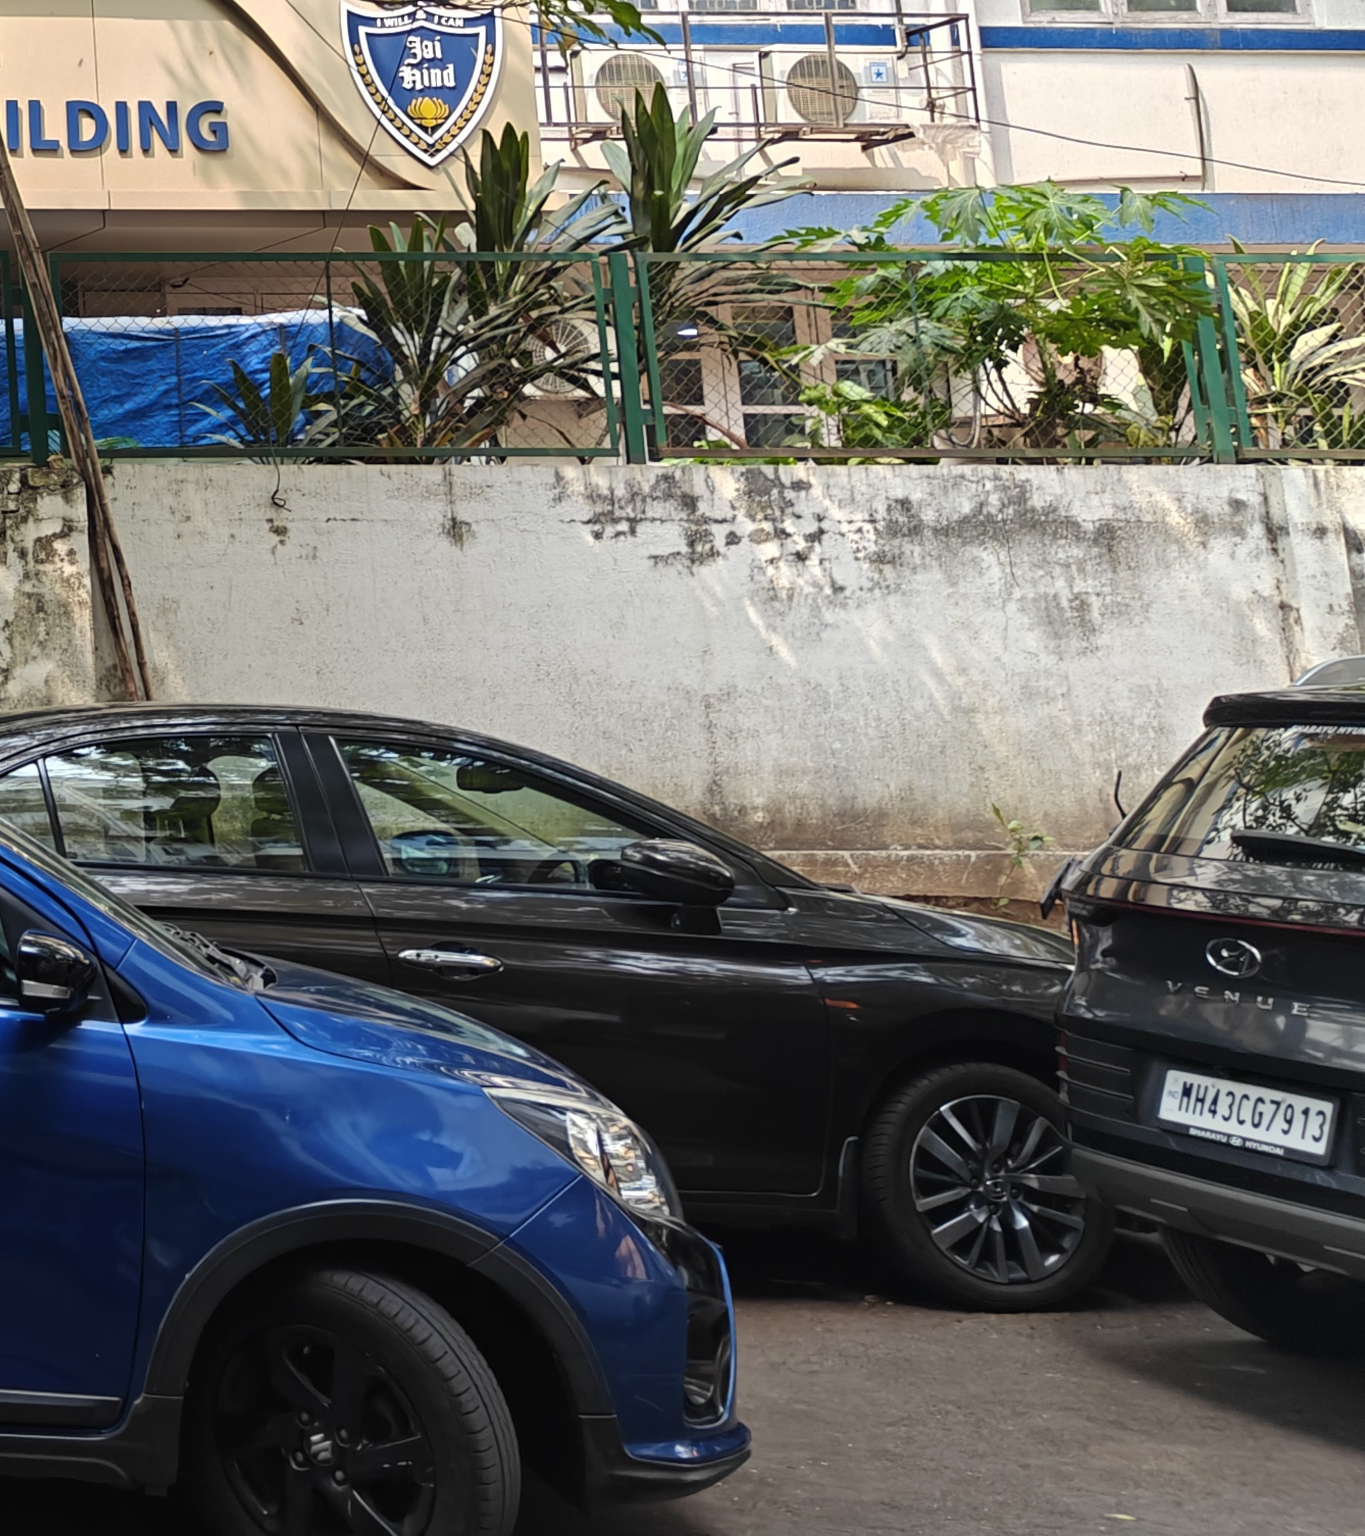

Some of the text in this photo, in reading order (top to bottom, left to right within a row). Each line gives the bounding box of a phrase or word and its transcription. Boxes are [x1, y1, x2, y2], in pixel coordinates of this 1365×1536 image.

[383, 15, 412, 27] WILL
[440, 18, 464, 27] CAN
[404, 35, 442, 65] Jai
[399, 63, 456, 90] Hind
[1166, 980, 1310, 1016] VENUE
[1178, 1081, 1327, 1143] MH43CG7913
[1188, 1127, 1284, 1156] SHARAYU HYUNDAI
